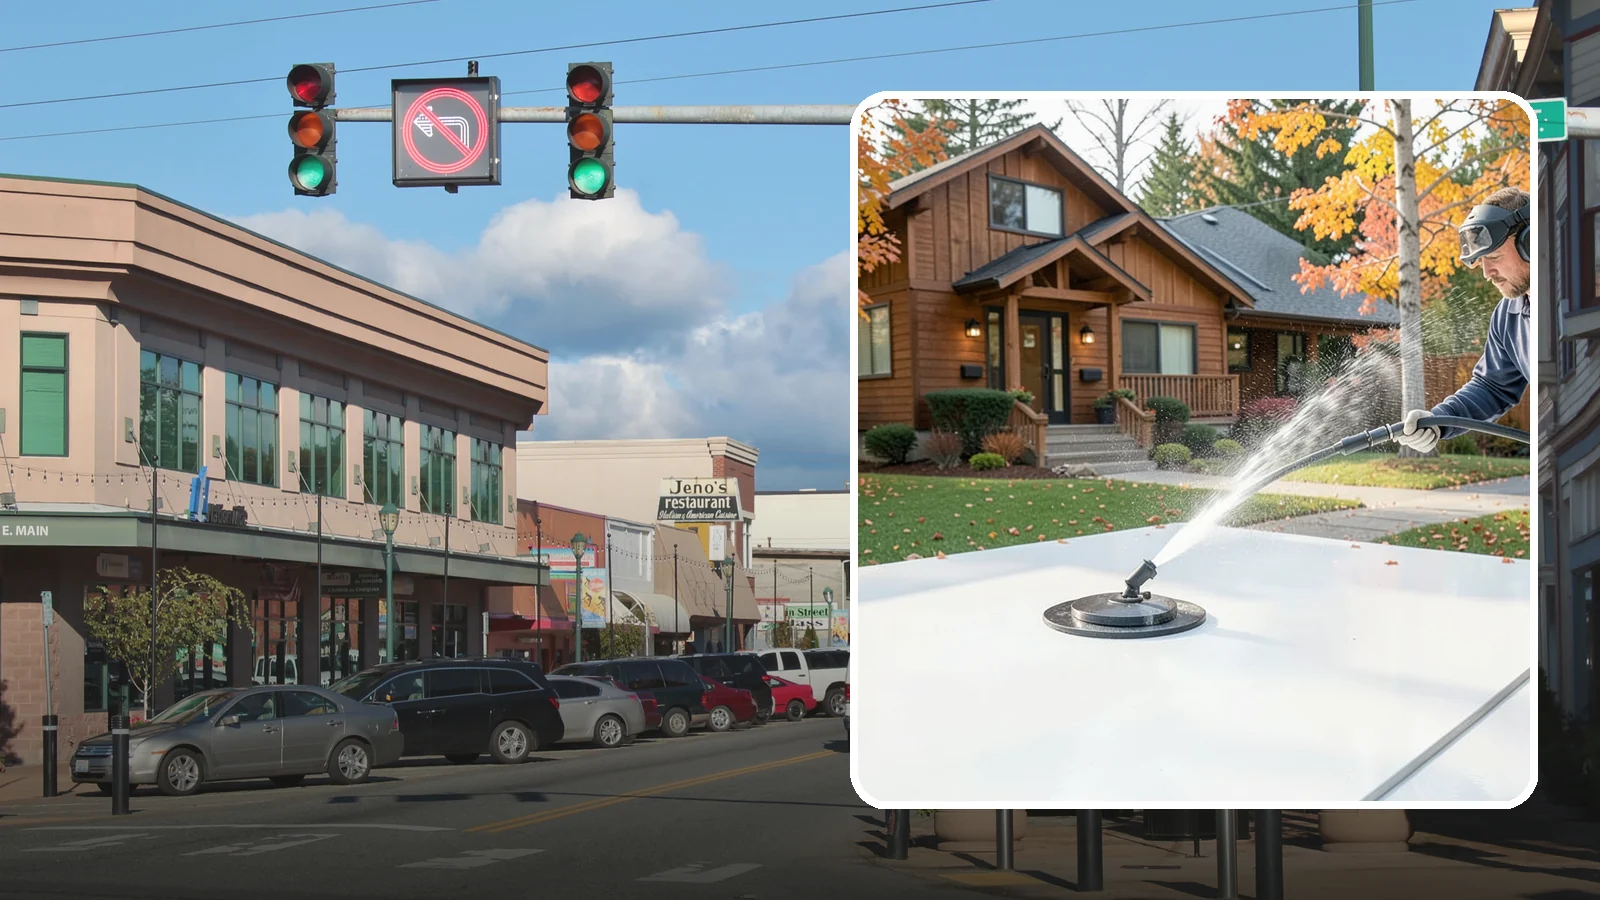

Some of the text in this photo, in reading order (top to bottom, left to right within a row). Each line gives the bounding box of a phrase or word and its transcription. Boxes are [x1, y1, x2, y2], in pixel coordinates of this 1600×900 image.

[670, 480, 727, 494] Jeno's
[665, 496, 731, 509] restaurant
[659, 510, 681, 519] Italian
[686, 510, 714, 519] American
[715, 509, 737, 519] Cuisine
[2, 525, 49, 536] E. MAIN
[797, 608, 828, 616] Street
